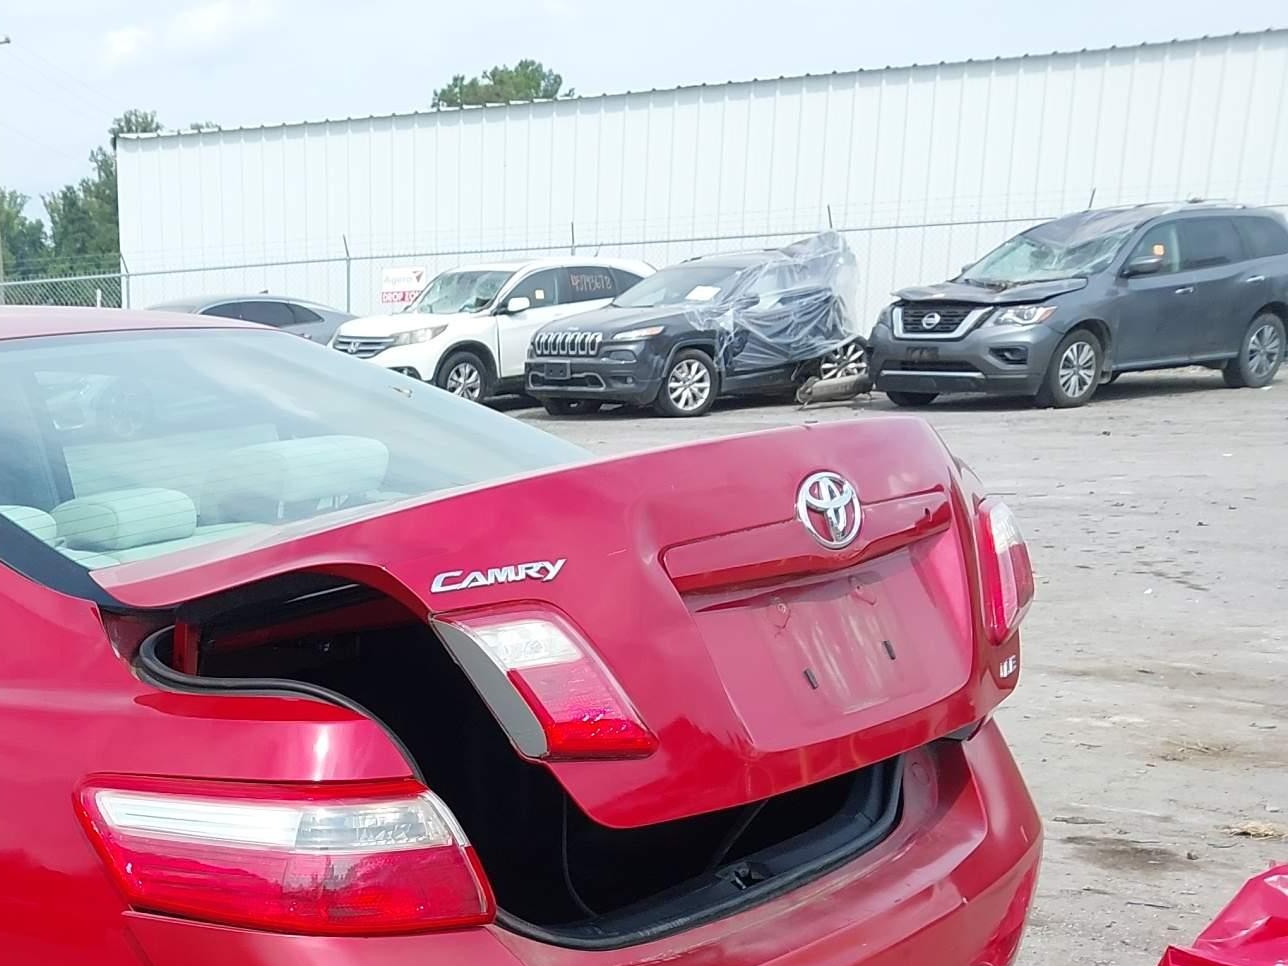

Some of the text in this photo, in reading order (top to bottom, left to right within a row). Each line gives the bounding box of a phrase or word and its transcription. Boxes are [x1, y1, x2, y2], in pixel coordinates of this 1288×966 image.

[382, 291, 402, 303] DROP
[430, 558, 567, 594] CAMRY
[999, 654, 1017, 678] LE
